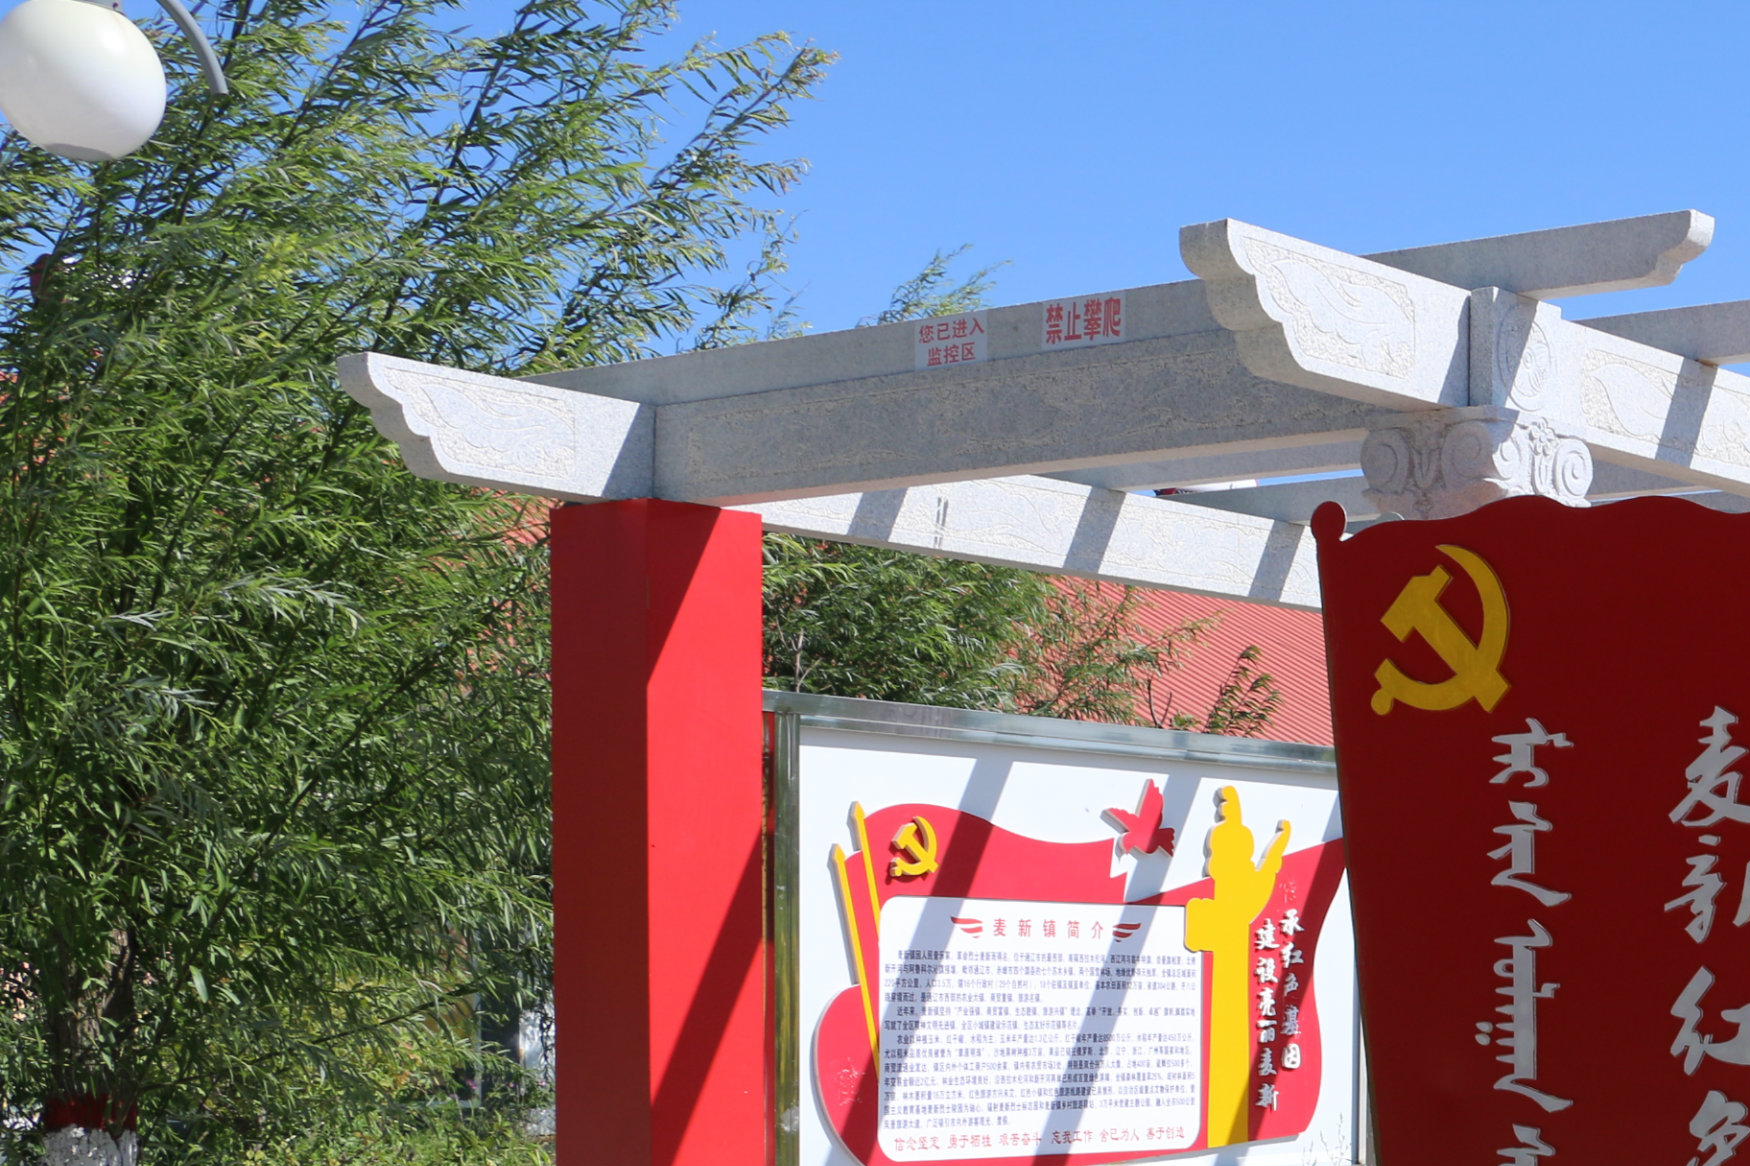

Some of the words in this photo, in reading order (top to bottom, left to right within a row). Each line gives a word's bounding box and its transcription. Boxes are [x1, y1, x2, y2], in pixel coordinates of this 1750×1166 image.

[918, 317, 985, 345] 您已进入
[1045, 296, 1122, 345] 禁止攀爬
[926, 341, 977, 368] 监控区
[993, 918, 1104, 939] 麦新镇简介
[1255, 918, 1280, 1112] 建设亮丽麦新
[894, 1136, 940, 1151] 信念坚定
[947, 1134, 992, 1149] 勇于牺牲
[999, 1131, 1043, 1146] 艰苦奋斗
[1051, 1130, 1093, 1144] 忘我工作
[1099, 1128, 1140, 1142] 舍己为人
[1146, 1126, 1185, 1140] 善于创造
